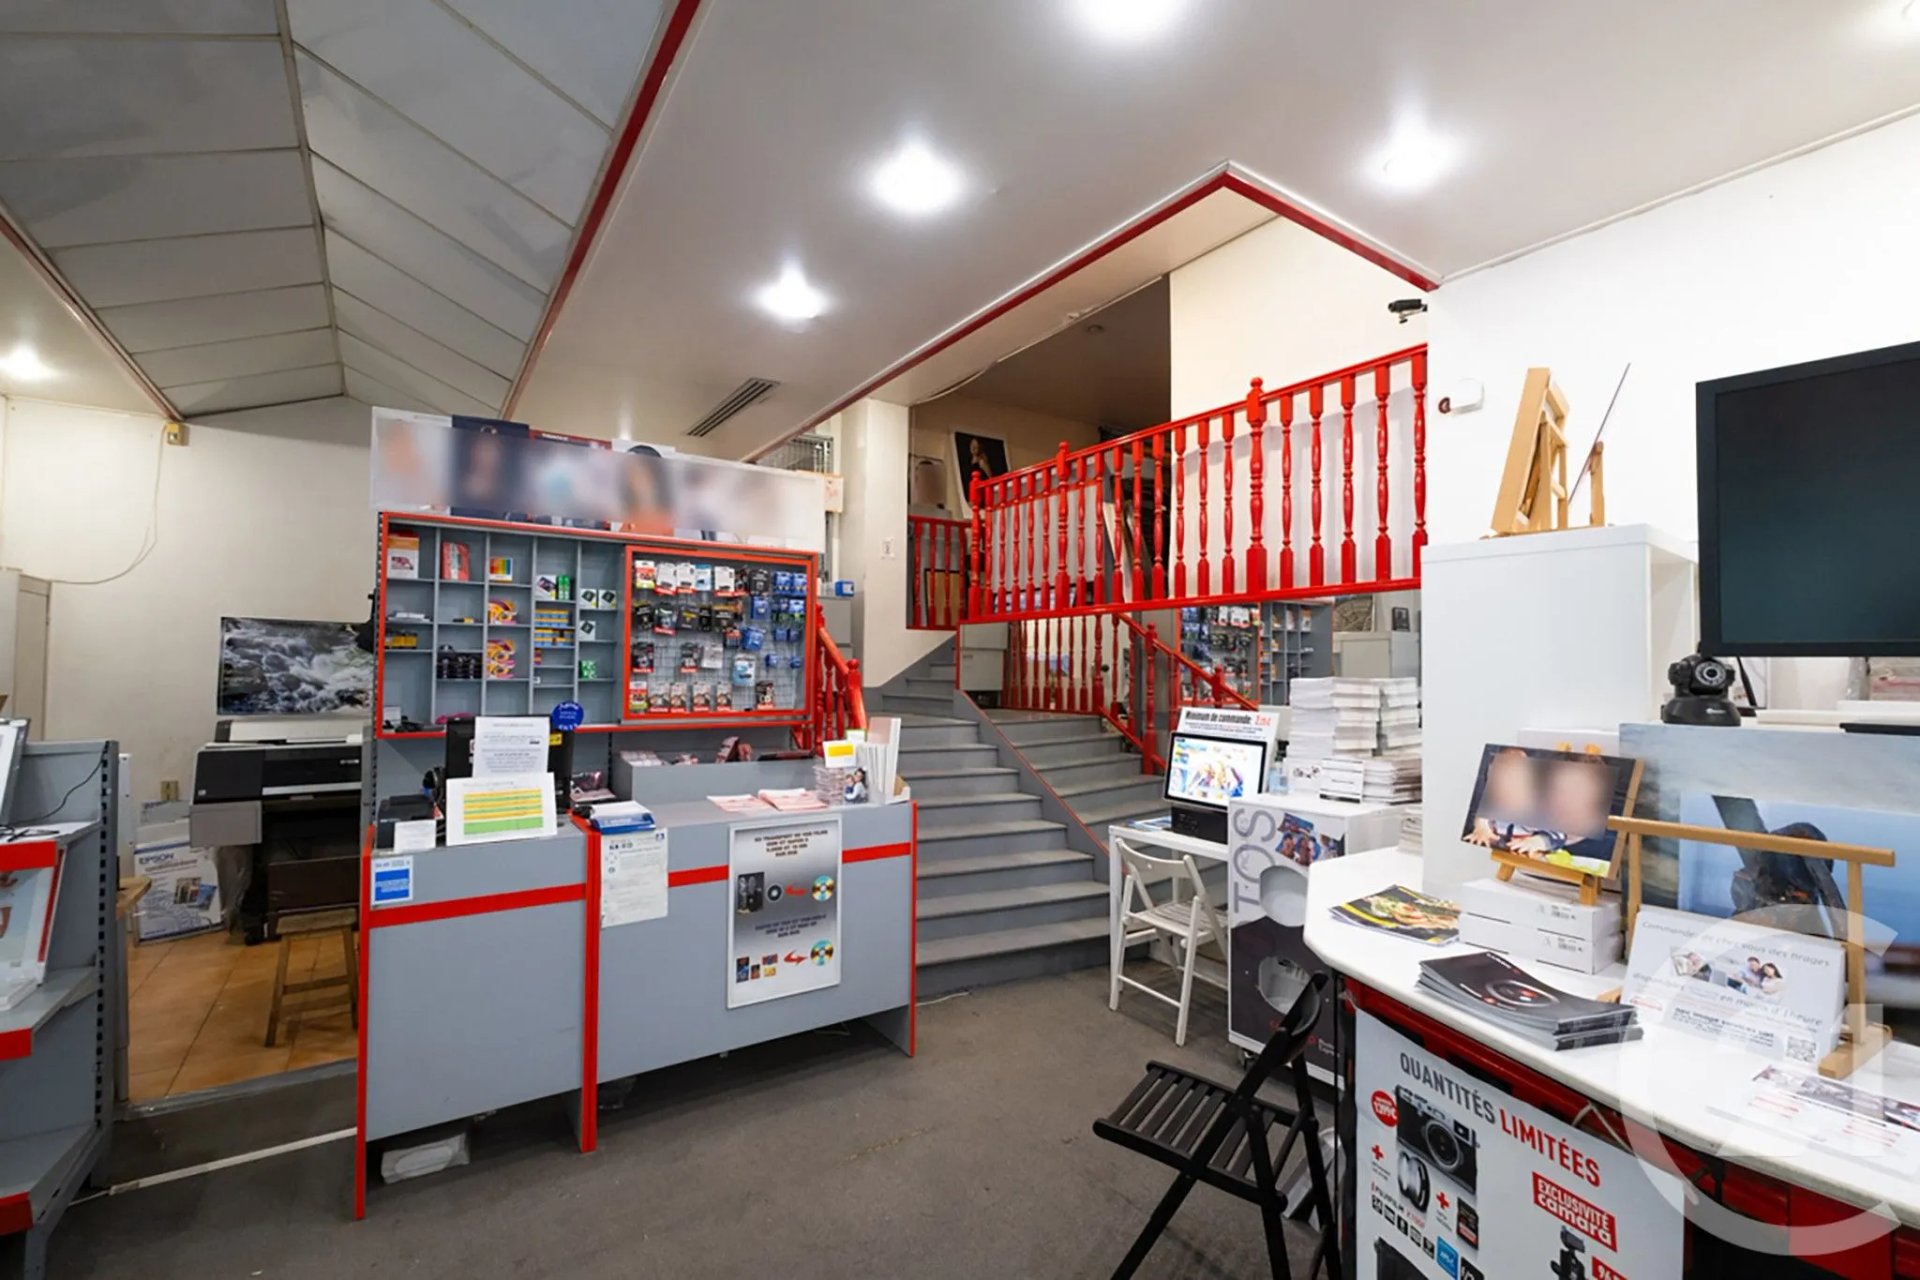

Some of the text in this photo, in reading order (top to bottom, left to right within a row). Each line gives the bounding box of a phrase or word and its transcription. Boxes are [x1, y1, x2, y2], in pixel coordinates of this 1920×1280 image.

[139, 853, 175, 865] EPSON
[1400, 1052, 1601, 1188] QUANTITÉS LIMITÉES
[1538, 1179, 1610, 1232] EXCLUSIVITÉ
[1538, 1193, 1612, 1246] camara
